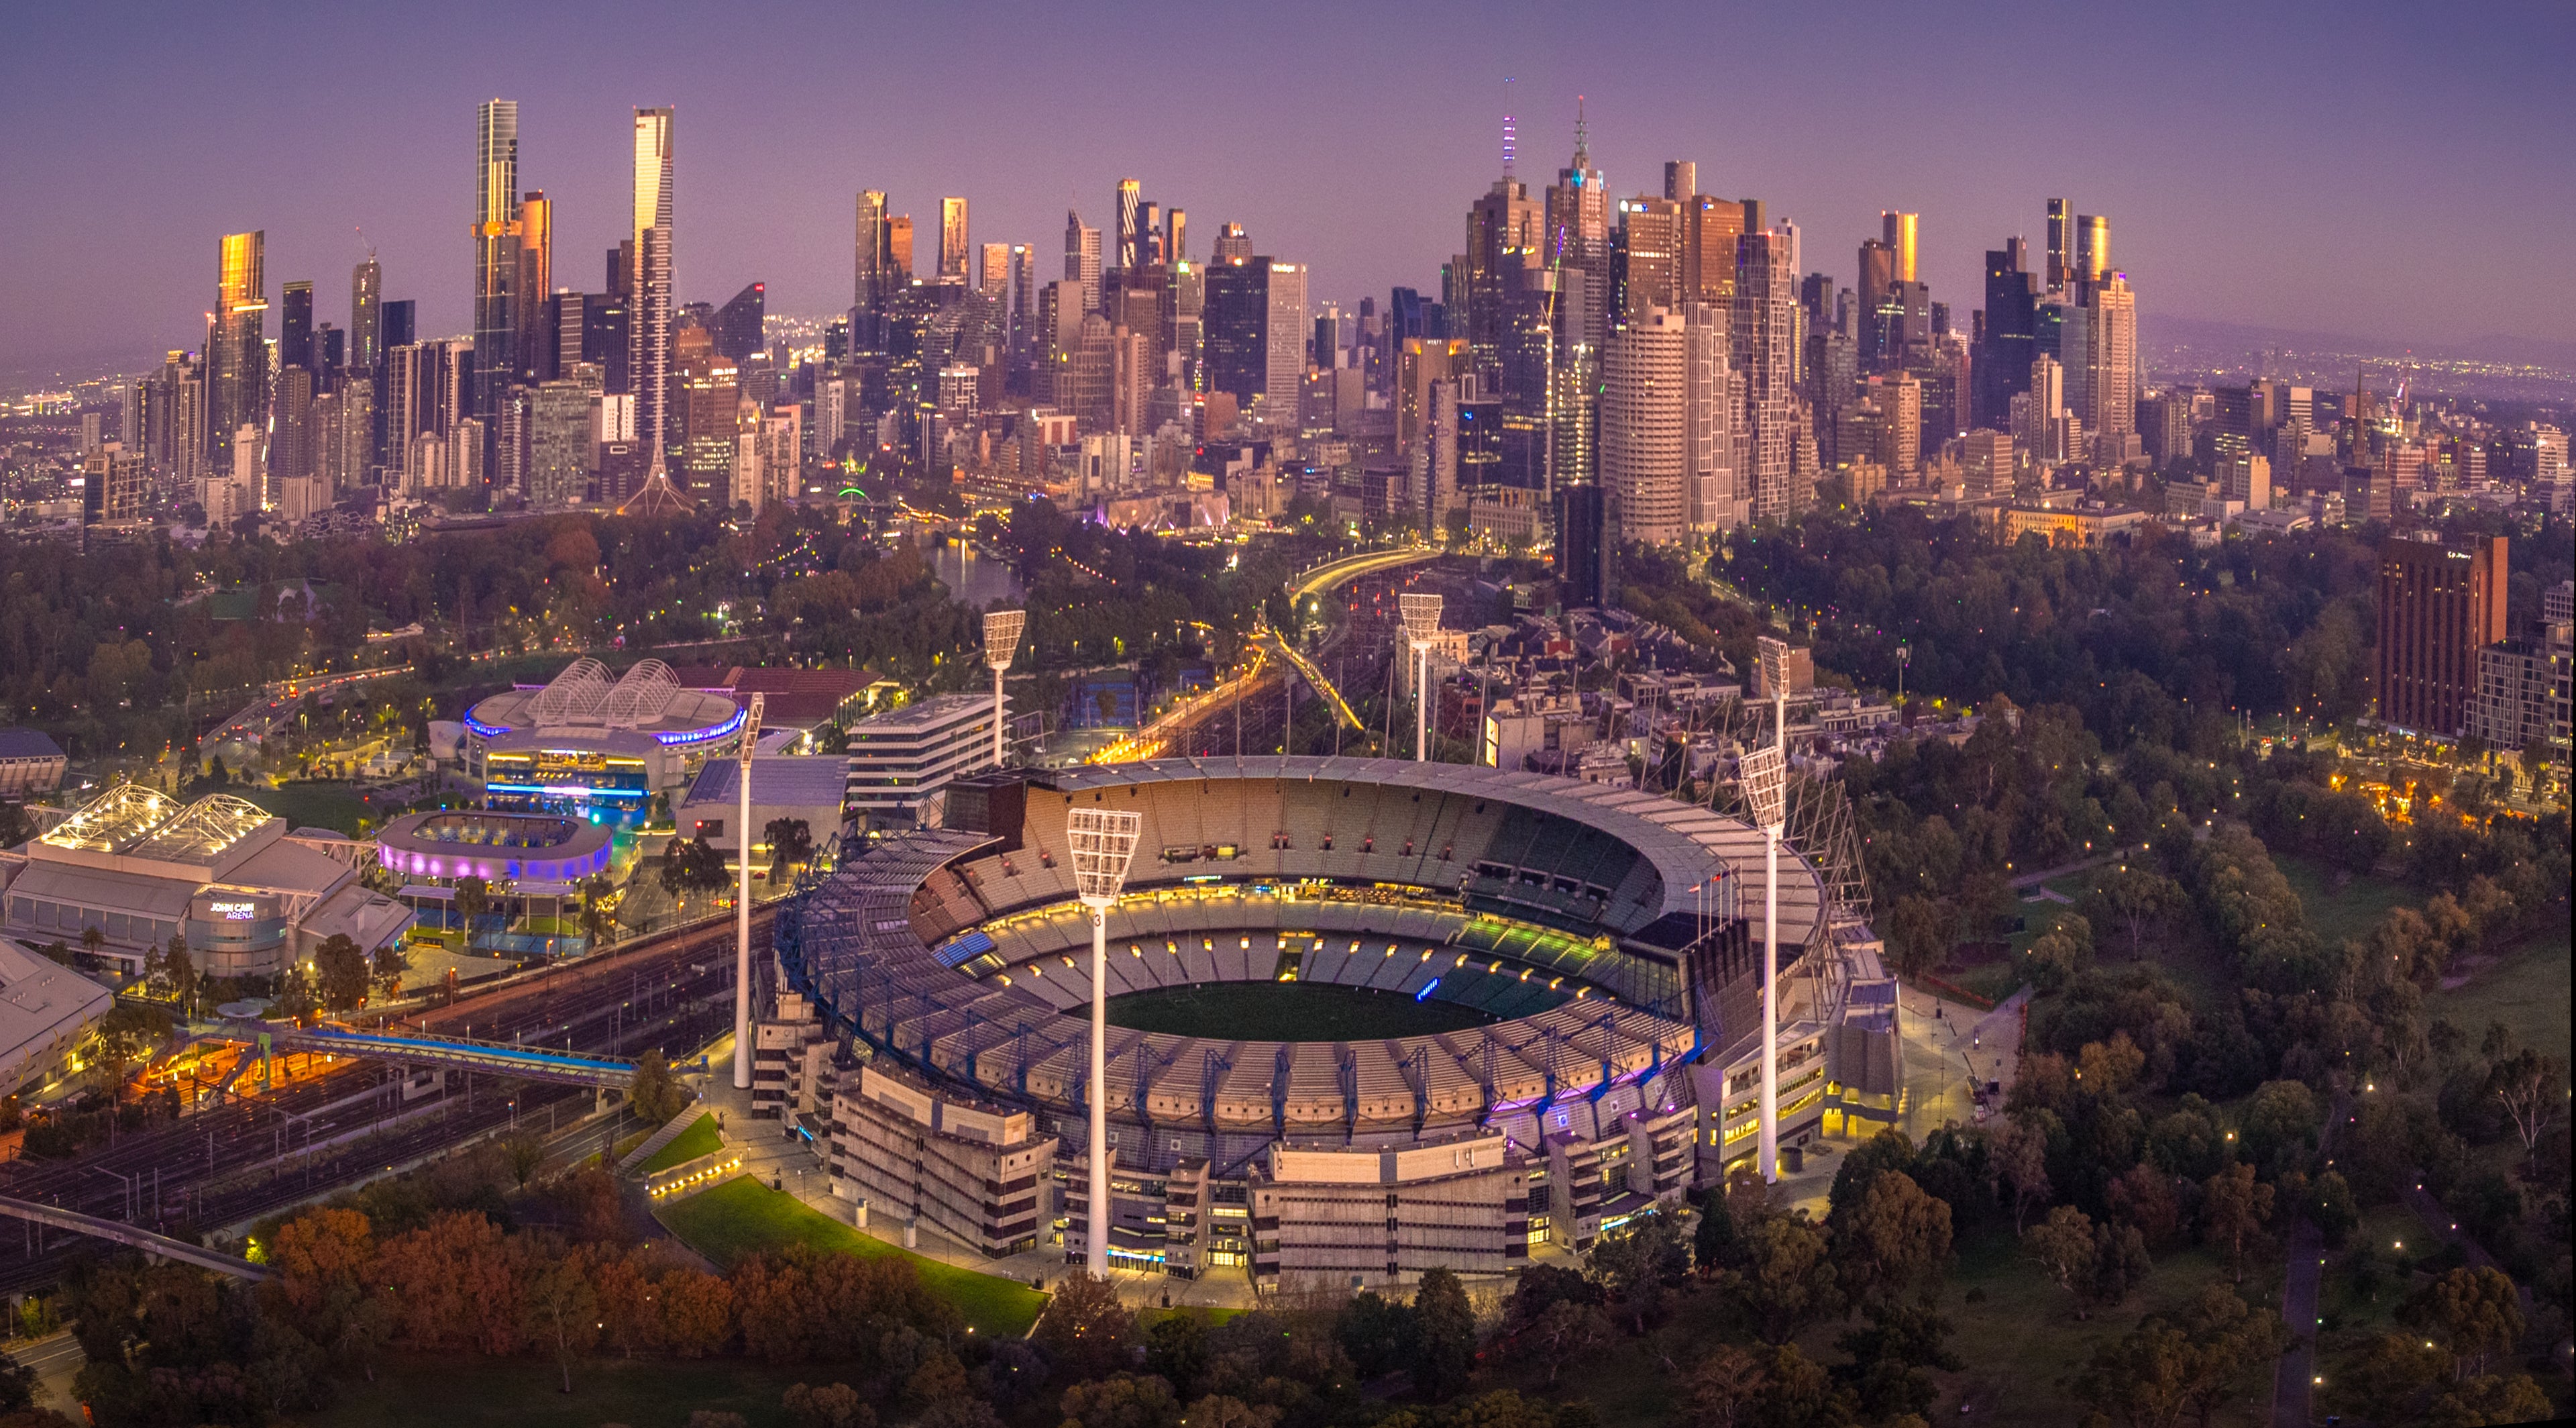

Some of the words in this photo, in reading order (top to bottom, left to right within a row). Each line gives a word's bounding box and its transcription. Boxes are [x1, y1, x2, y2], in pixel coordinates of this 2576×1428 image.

[210, 902, 233, 913] JOHN
[234, 903, 254, 913] CAIN
[226, 911, 254, 919] ARENA
[1095, 914, 1101, 927] 3
